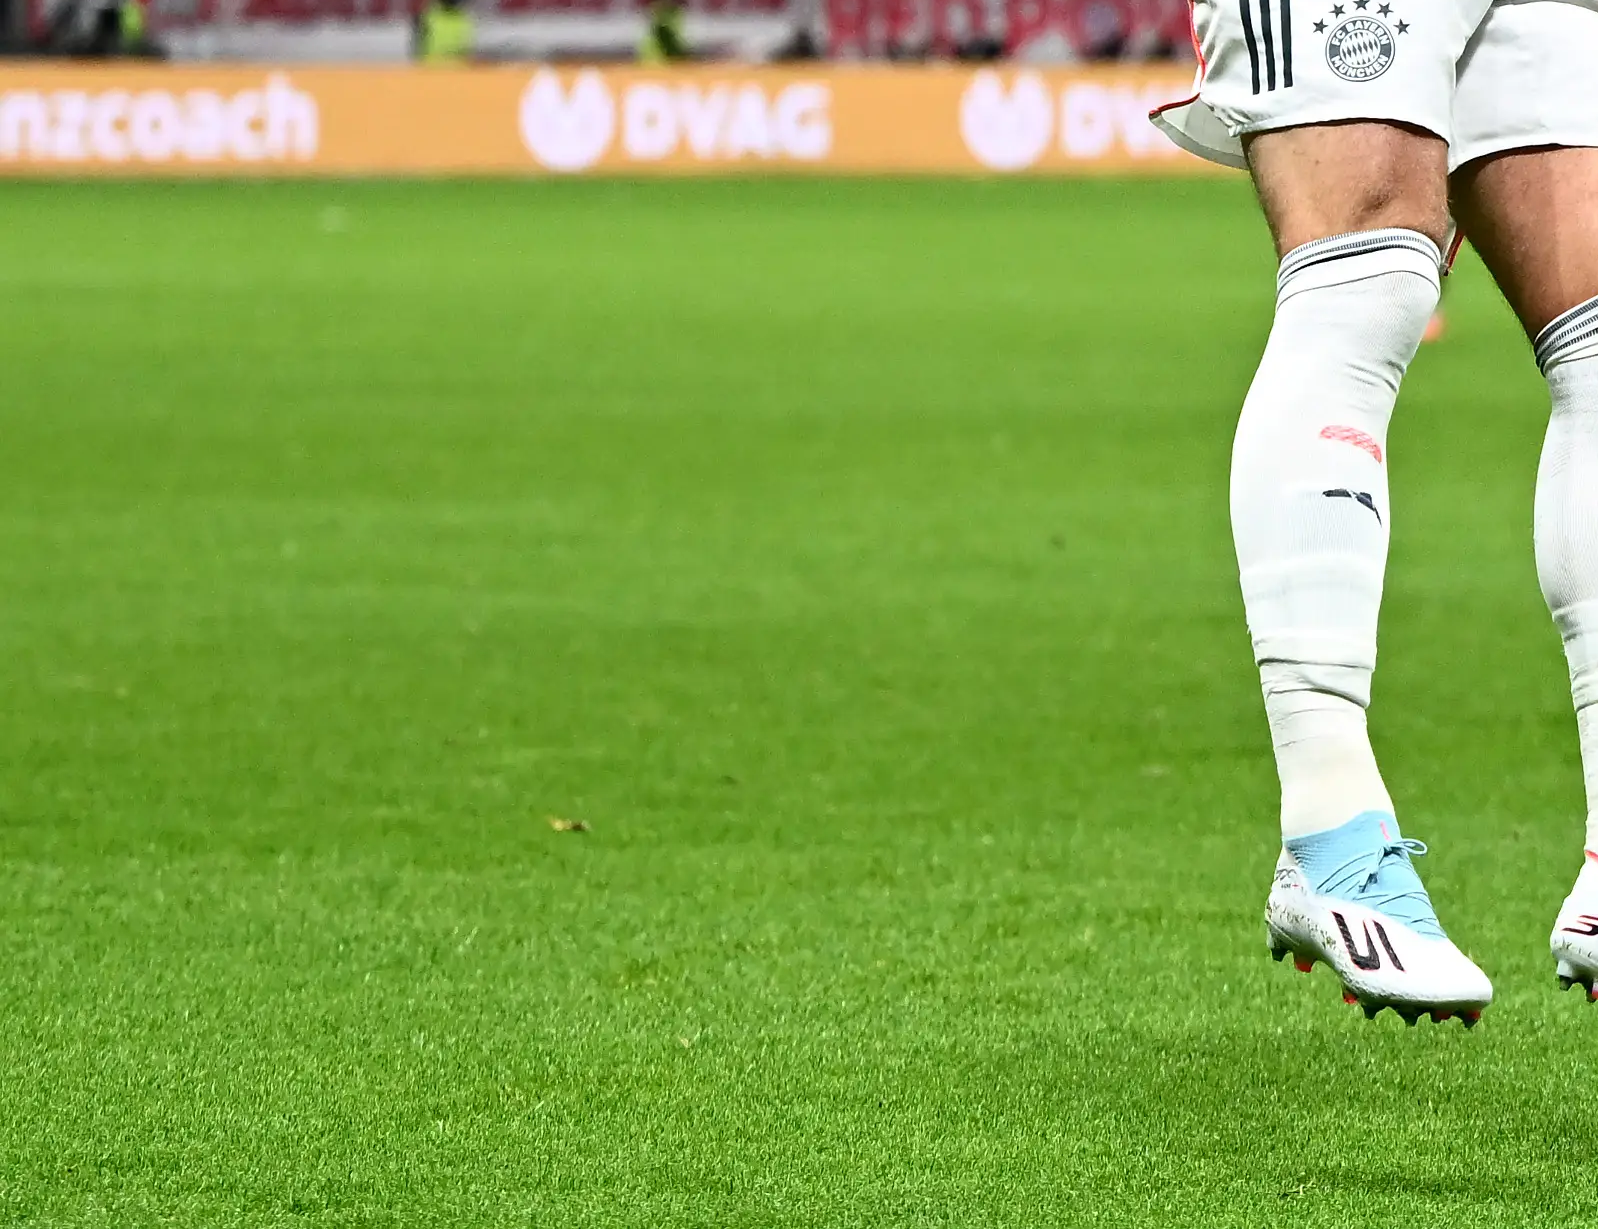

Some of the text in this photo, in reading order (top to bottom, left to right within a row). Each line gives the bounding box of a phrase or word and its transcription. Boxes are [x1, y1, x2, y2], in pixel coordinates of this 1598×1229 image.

[1331, 20, 1390, 46] FC BAYERN
[622, 82, 832, 160] DVAG
